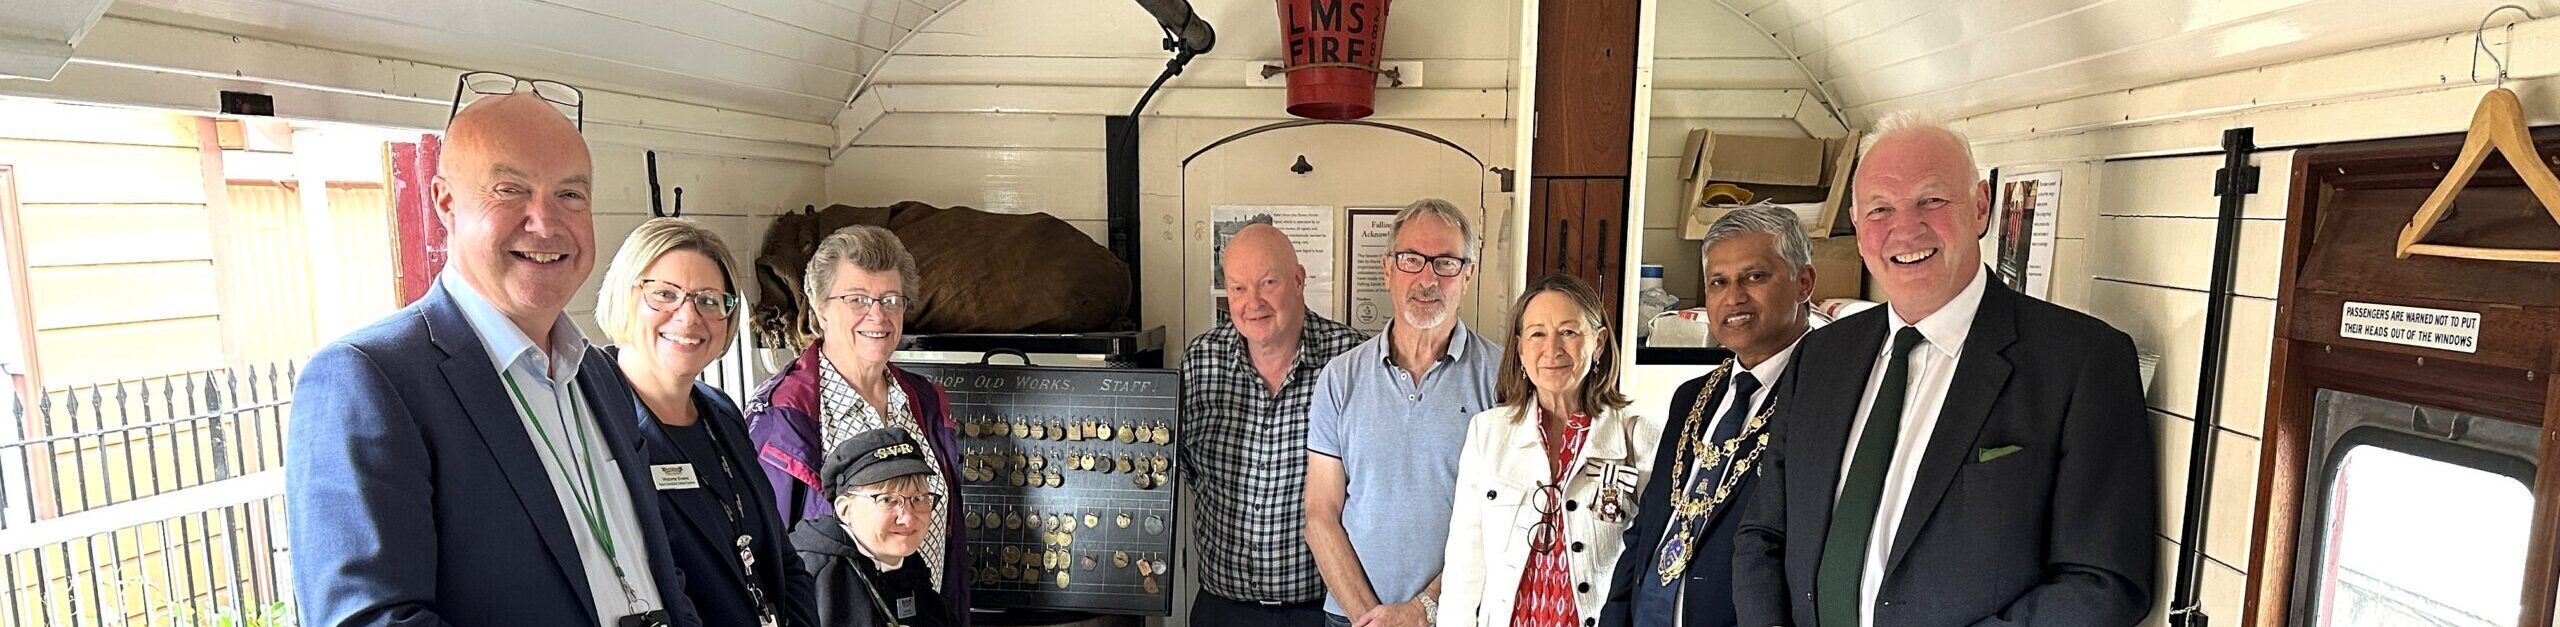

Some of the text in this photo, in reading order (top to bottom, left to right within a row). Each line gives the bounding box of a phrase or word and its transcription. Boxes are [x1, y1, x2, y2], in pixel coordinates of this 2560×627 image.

[1288, 0, 1365, 34] LMS
[1290, 37, 1364, 67] FIRE
[1371, 221, 1392, 229] Fallin
[2346, 306, 2477, 329] PASSENGERS ARE WARNED NOT TO PUT
[2344, 323, 2473, 347] THEIR HEADS OUT OF THE WINDOWS
